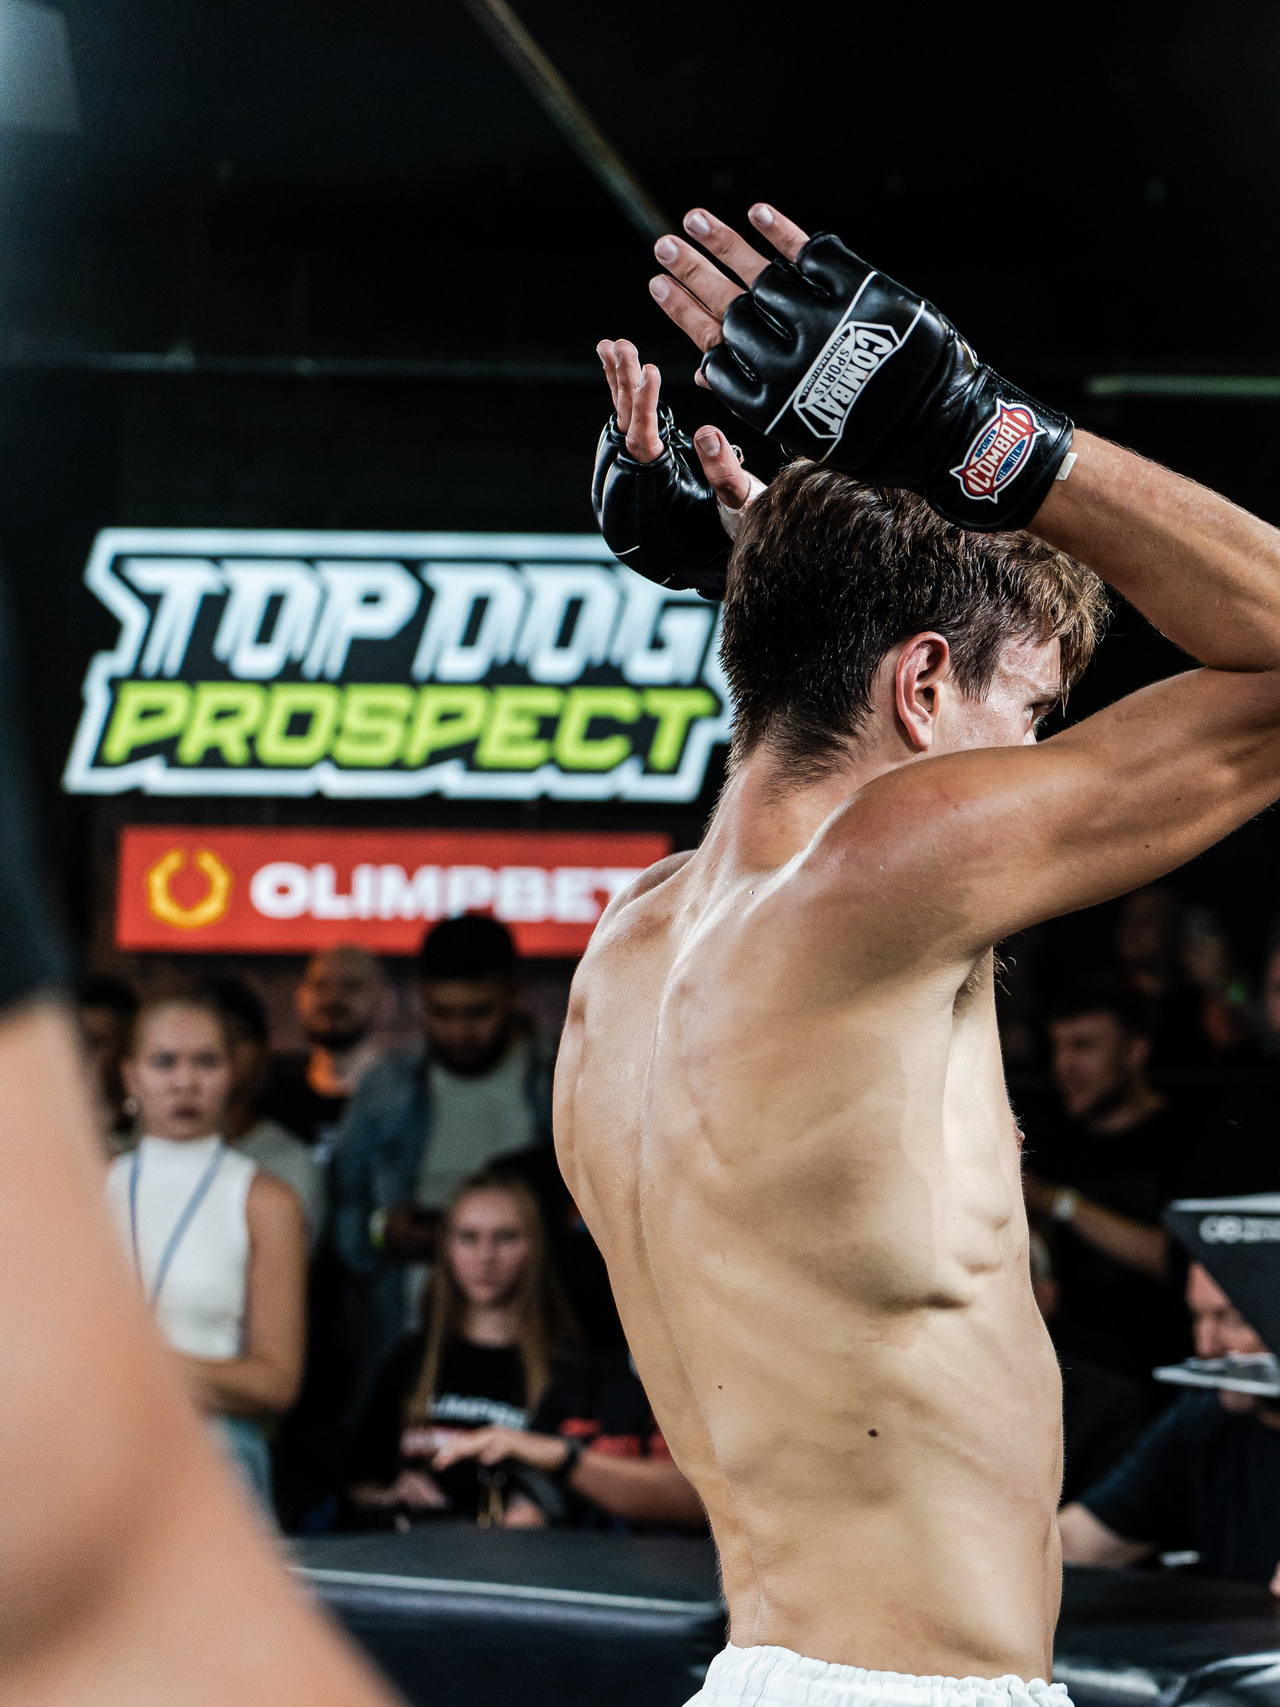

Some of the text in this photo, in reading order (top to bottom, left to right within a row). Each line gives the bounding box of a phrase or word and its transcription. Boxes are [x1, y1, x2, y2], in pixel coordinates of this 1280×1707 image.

[802, 335, 847, 397] INTERNATIONAL
[804, 329, 894, 435] COMBAT
[814, 348, 850, 396] SPORTS
[965, 412, 1028, 488] COMBAT
[974, 429, 997, 459] SPORTS
[117, 557, 717, 685] TOP DOG
[101, 681, 716, 771] PROSPECT
